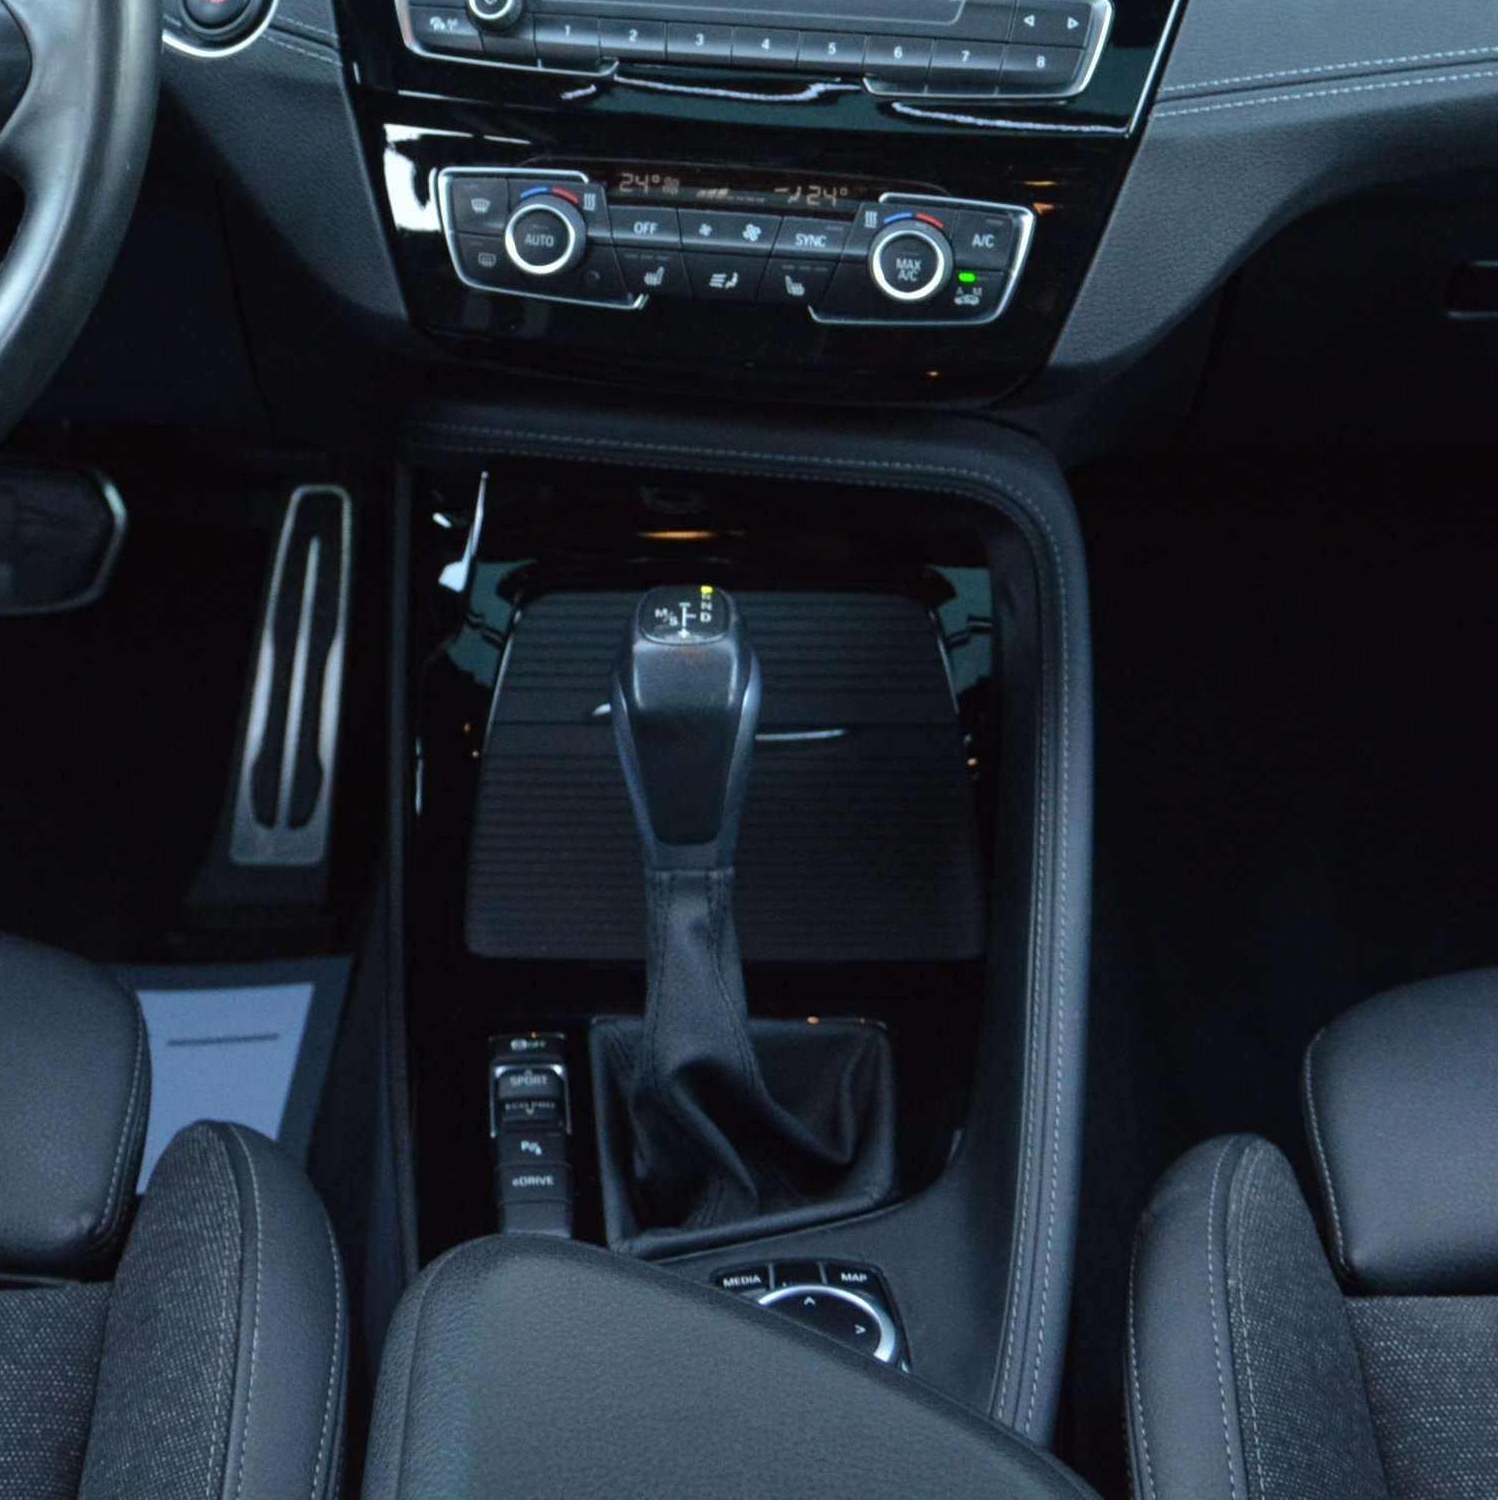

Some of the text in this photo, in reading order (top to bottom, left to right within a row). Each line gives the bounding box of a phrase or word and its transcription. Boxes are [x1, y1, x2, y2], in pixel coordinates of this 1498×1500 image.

[564, 25, 571, 37] 1
[628, 29, 638, 43] 2
[695, 33, 705, 47] 3
[761, 38, 771, 52] 4
[828, 41, 837, 55] 5
[893, 46, 903, 60] 6
[961, 50, 971, 63] 7
[1036, 54, 1046, 69] 8
[633, 221, 657, 236] OFF
[524, 233, 555, 248] AUTO
[795, 233, 828, 248] SYNC
[971, 233, 996, 249] A/C
[895, 257, 922, 271] MAX
[700, 611, 712, 622] D
[509, 1073, 548, 1086] SPORT
[723, 1275, 761, 1288] MEDIA
[841, 1272, 868, 1283] MAP
